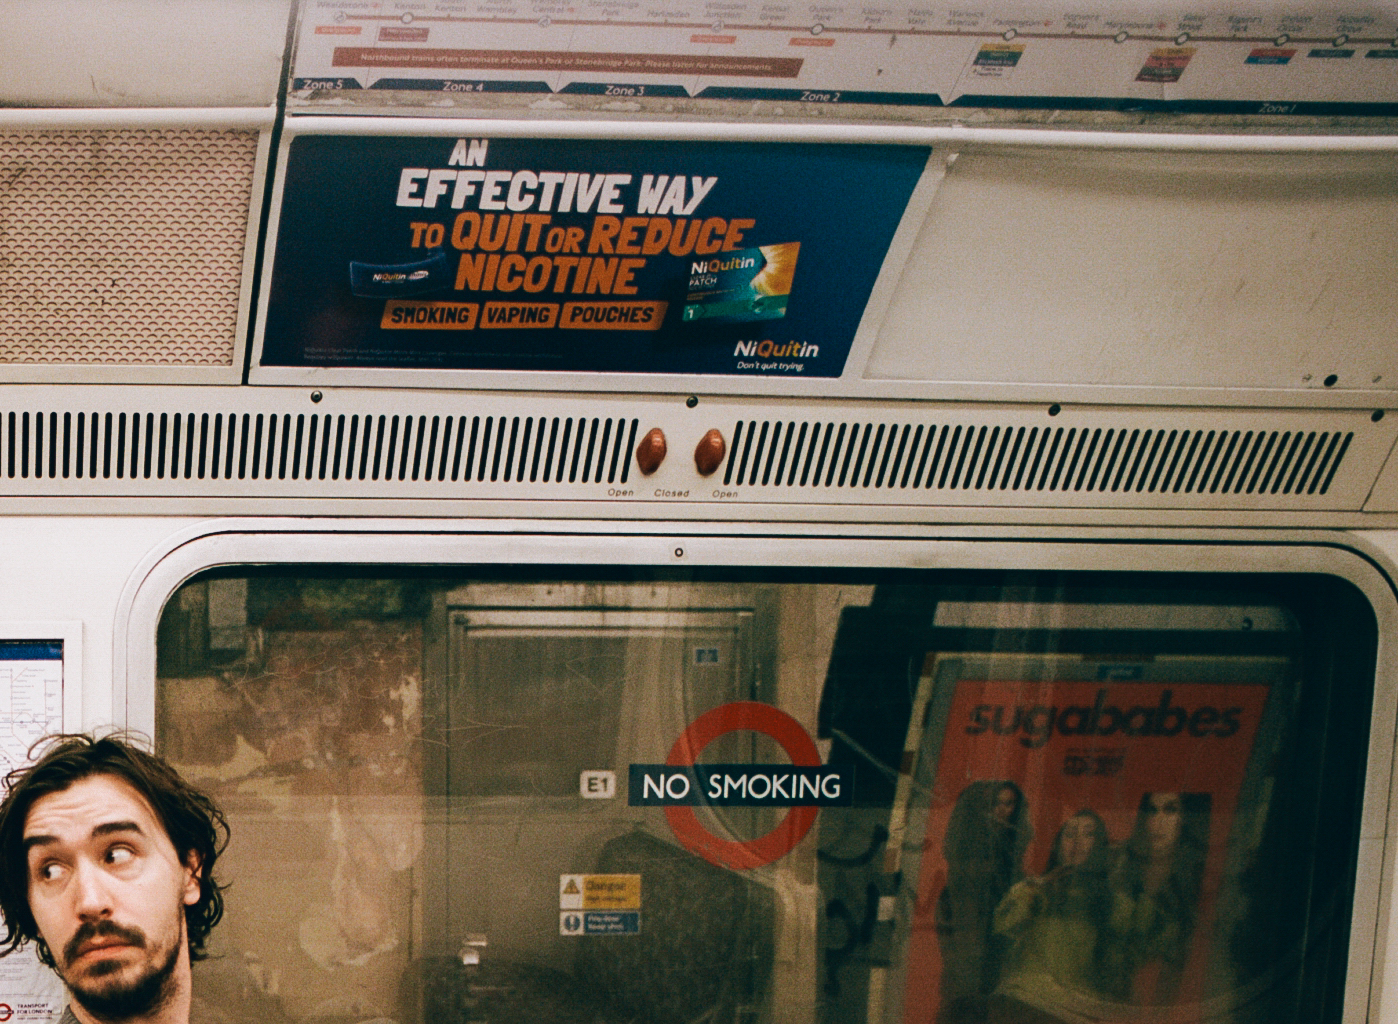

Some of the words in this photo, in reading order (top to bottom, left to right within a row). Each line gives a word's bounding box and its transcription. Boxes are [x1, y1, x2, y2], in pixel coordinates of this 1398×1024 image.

[360, 53, 410, 62] Northbound
[436, 54, 458, 63] often
[460, 56, 498, 64] terminate
[511, 57, 543, 65] Queen's
[545, 57, 562, 65] Park
[576, 58, 622, 67] Stonebridge
[304, 80, 334, 90] Zone
[335, 80, 343, 89] 5
[443, 82, 473, 92] Zone
[475, 83, 483, 92] 4
[605, 85, 635, 96] Zone
[637, 86, 644, 96] 3
[801, 91, 830, 101] Zone
[833, 92, 840, 101] 2
[1259, 103, 1288, 113] Zone
[448, 138, 488, 167] AN
[396, 168, 632, 213] EFFECTIVE
[637, 175, 718, 215] WAY
[409, 221, 445, 249] TO
[450, 211, 552, 253] QUIT
[545, 225, 585, 253] OR
[586, 215, 756, 257] REDUCE
[691, 256, 755, 275] NiQuitin
[454, 253, 646, 295] NICOTINE
[689, 277, 718, 287] PATCH
[391, 306, 470, 325] SMOKING
[487, 306, 551, 323] VAPING
[570, 306, 655, 324] POUCHES
[733, 339, 819, 358] NiQuitin
[737, 361, 760, 370] Don't
[761, 362, 778, 371] quit
[779, 362, 805, 373] trying.
[608, 488, 634, 498] Open
[654, 489, 690, 498] Closed
[712, 490, 738, 499] Open
[964, 690, 1244, 749] sugababes
[587, 776, 609, 793] E1
[643, 773, 690, 799] NO
[708, 773, 841, 799] SMOKING
[585, 880, 627, 892] Danger
